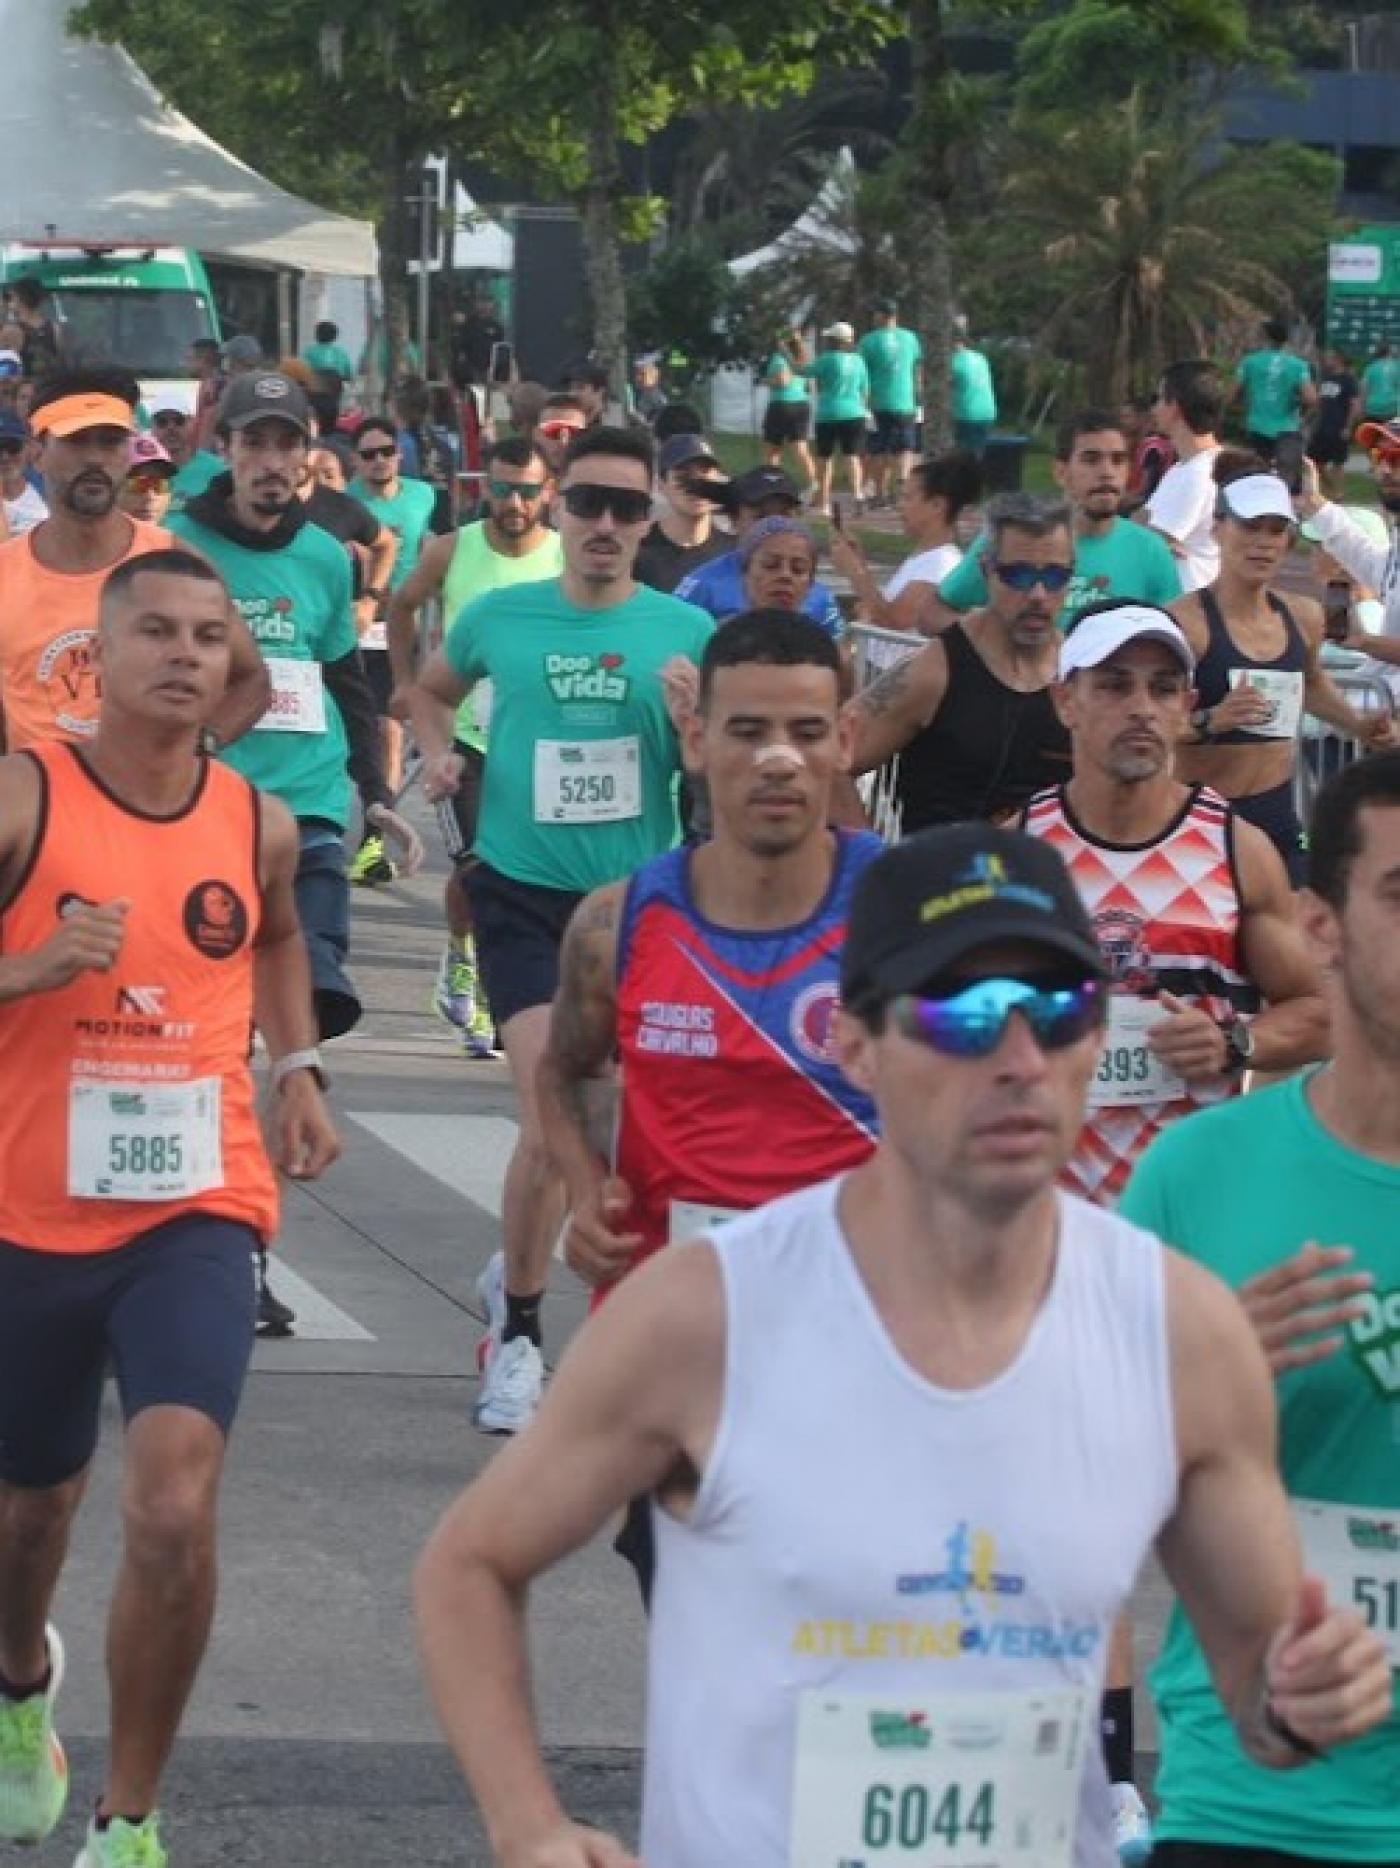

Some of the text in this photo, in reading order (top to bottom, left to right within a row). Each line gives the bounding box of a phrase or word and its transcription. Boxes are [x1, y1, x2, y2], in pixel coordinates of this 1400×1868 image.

[550, 668, 626, 701] vida
[559, 775, 615, 804] 5250
[74, 1020, 196, 1038] MOTIONFIT
[110, 1133, 183, 1174] 5885
[792, 1619, 962, 1659] ATLETAS
[861, 1779, 995, 1850] 6044
